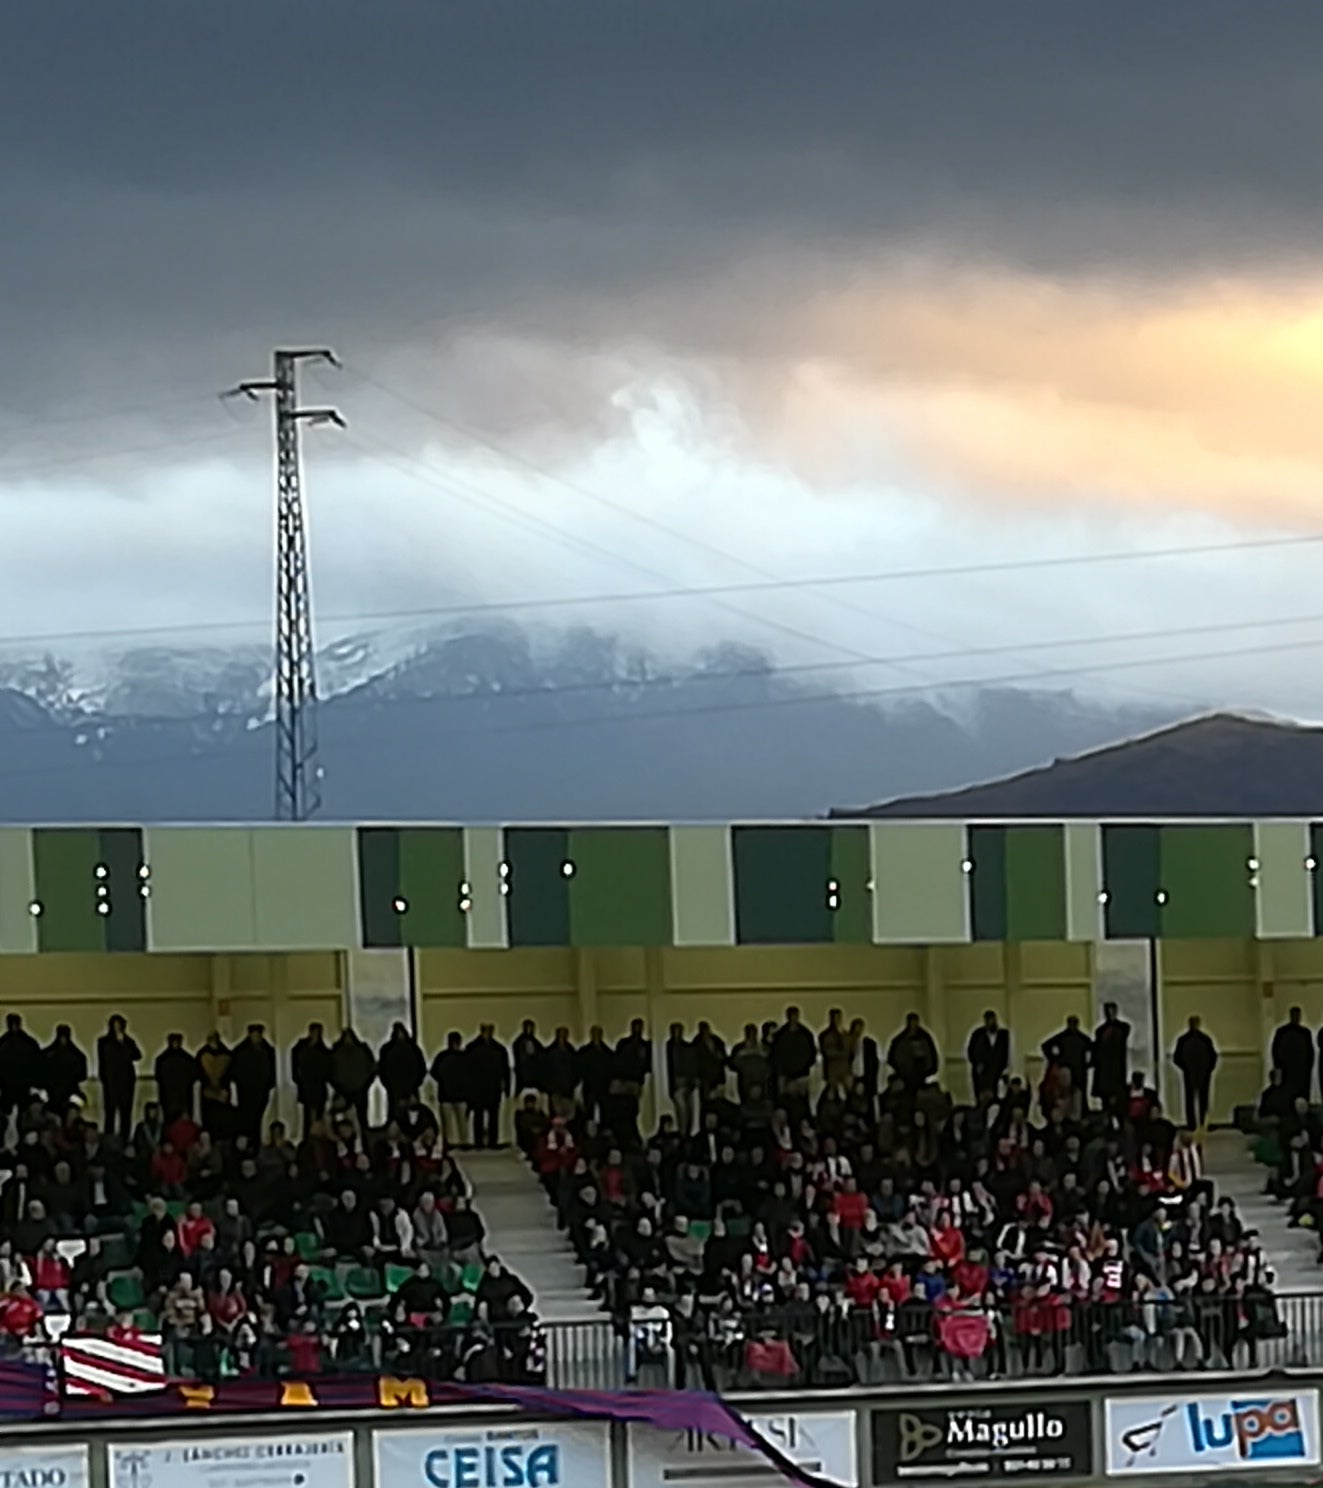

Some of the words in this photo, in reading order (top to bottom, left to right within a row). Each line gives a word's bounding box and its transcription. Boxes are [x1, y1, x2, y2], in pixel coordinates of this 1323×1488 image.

[947, 1412, 1064, 1447] Magullo
[1187, 1399, 1300, 1460] lupa
[425, 1444, 559, 1488] CEISA
